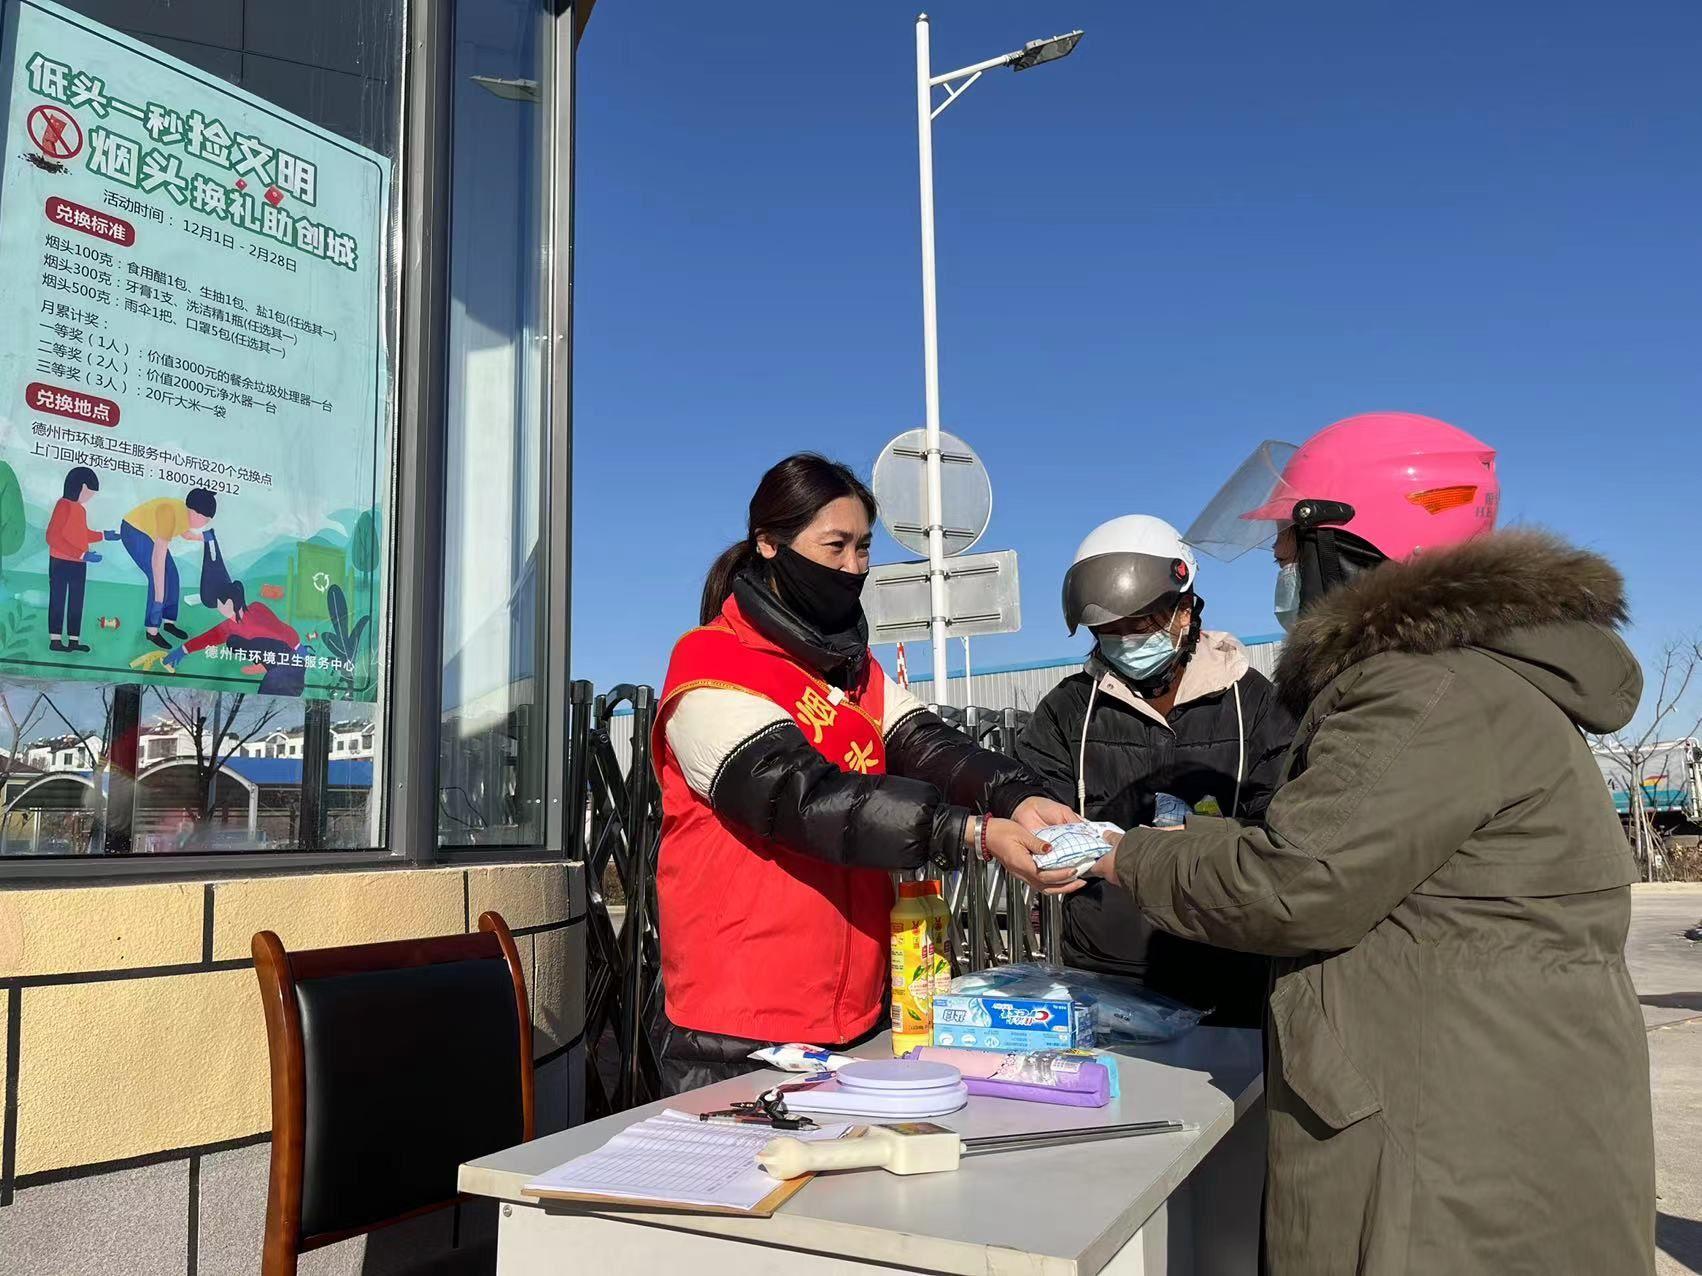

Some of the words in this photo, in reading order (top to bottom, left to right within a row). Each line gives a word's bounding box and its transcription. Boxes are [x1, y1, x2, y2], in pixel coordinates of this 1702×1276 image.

[26, 51, 318, 207] 低头一秒捡文明
[88, 126, 358, 271] 烟头换礼助创城
[55, 203, 126, 241] 兑换标准
[41, 300, 108, 329] 月累计奖：
[36, 389, 111, 421] 兑换地点
[31, 421, 273, 486] 德州市环境卫生服务中心所设20个兑换点
[204, 644, 355, 672] 德州市环境卫生服务中心
[1000, 1009, 1049, 1022] Crest
